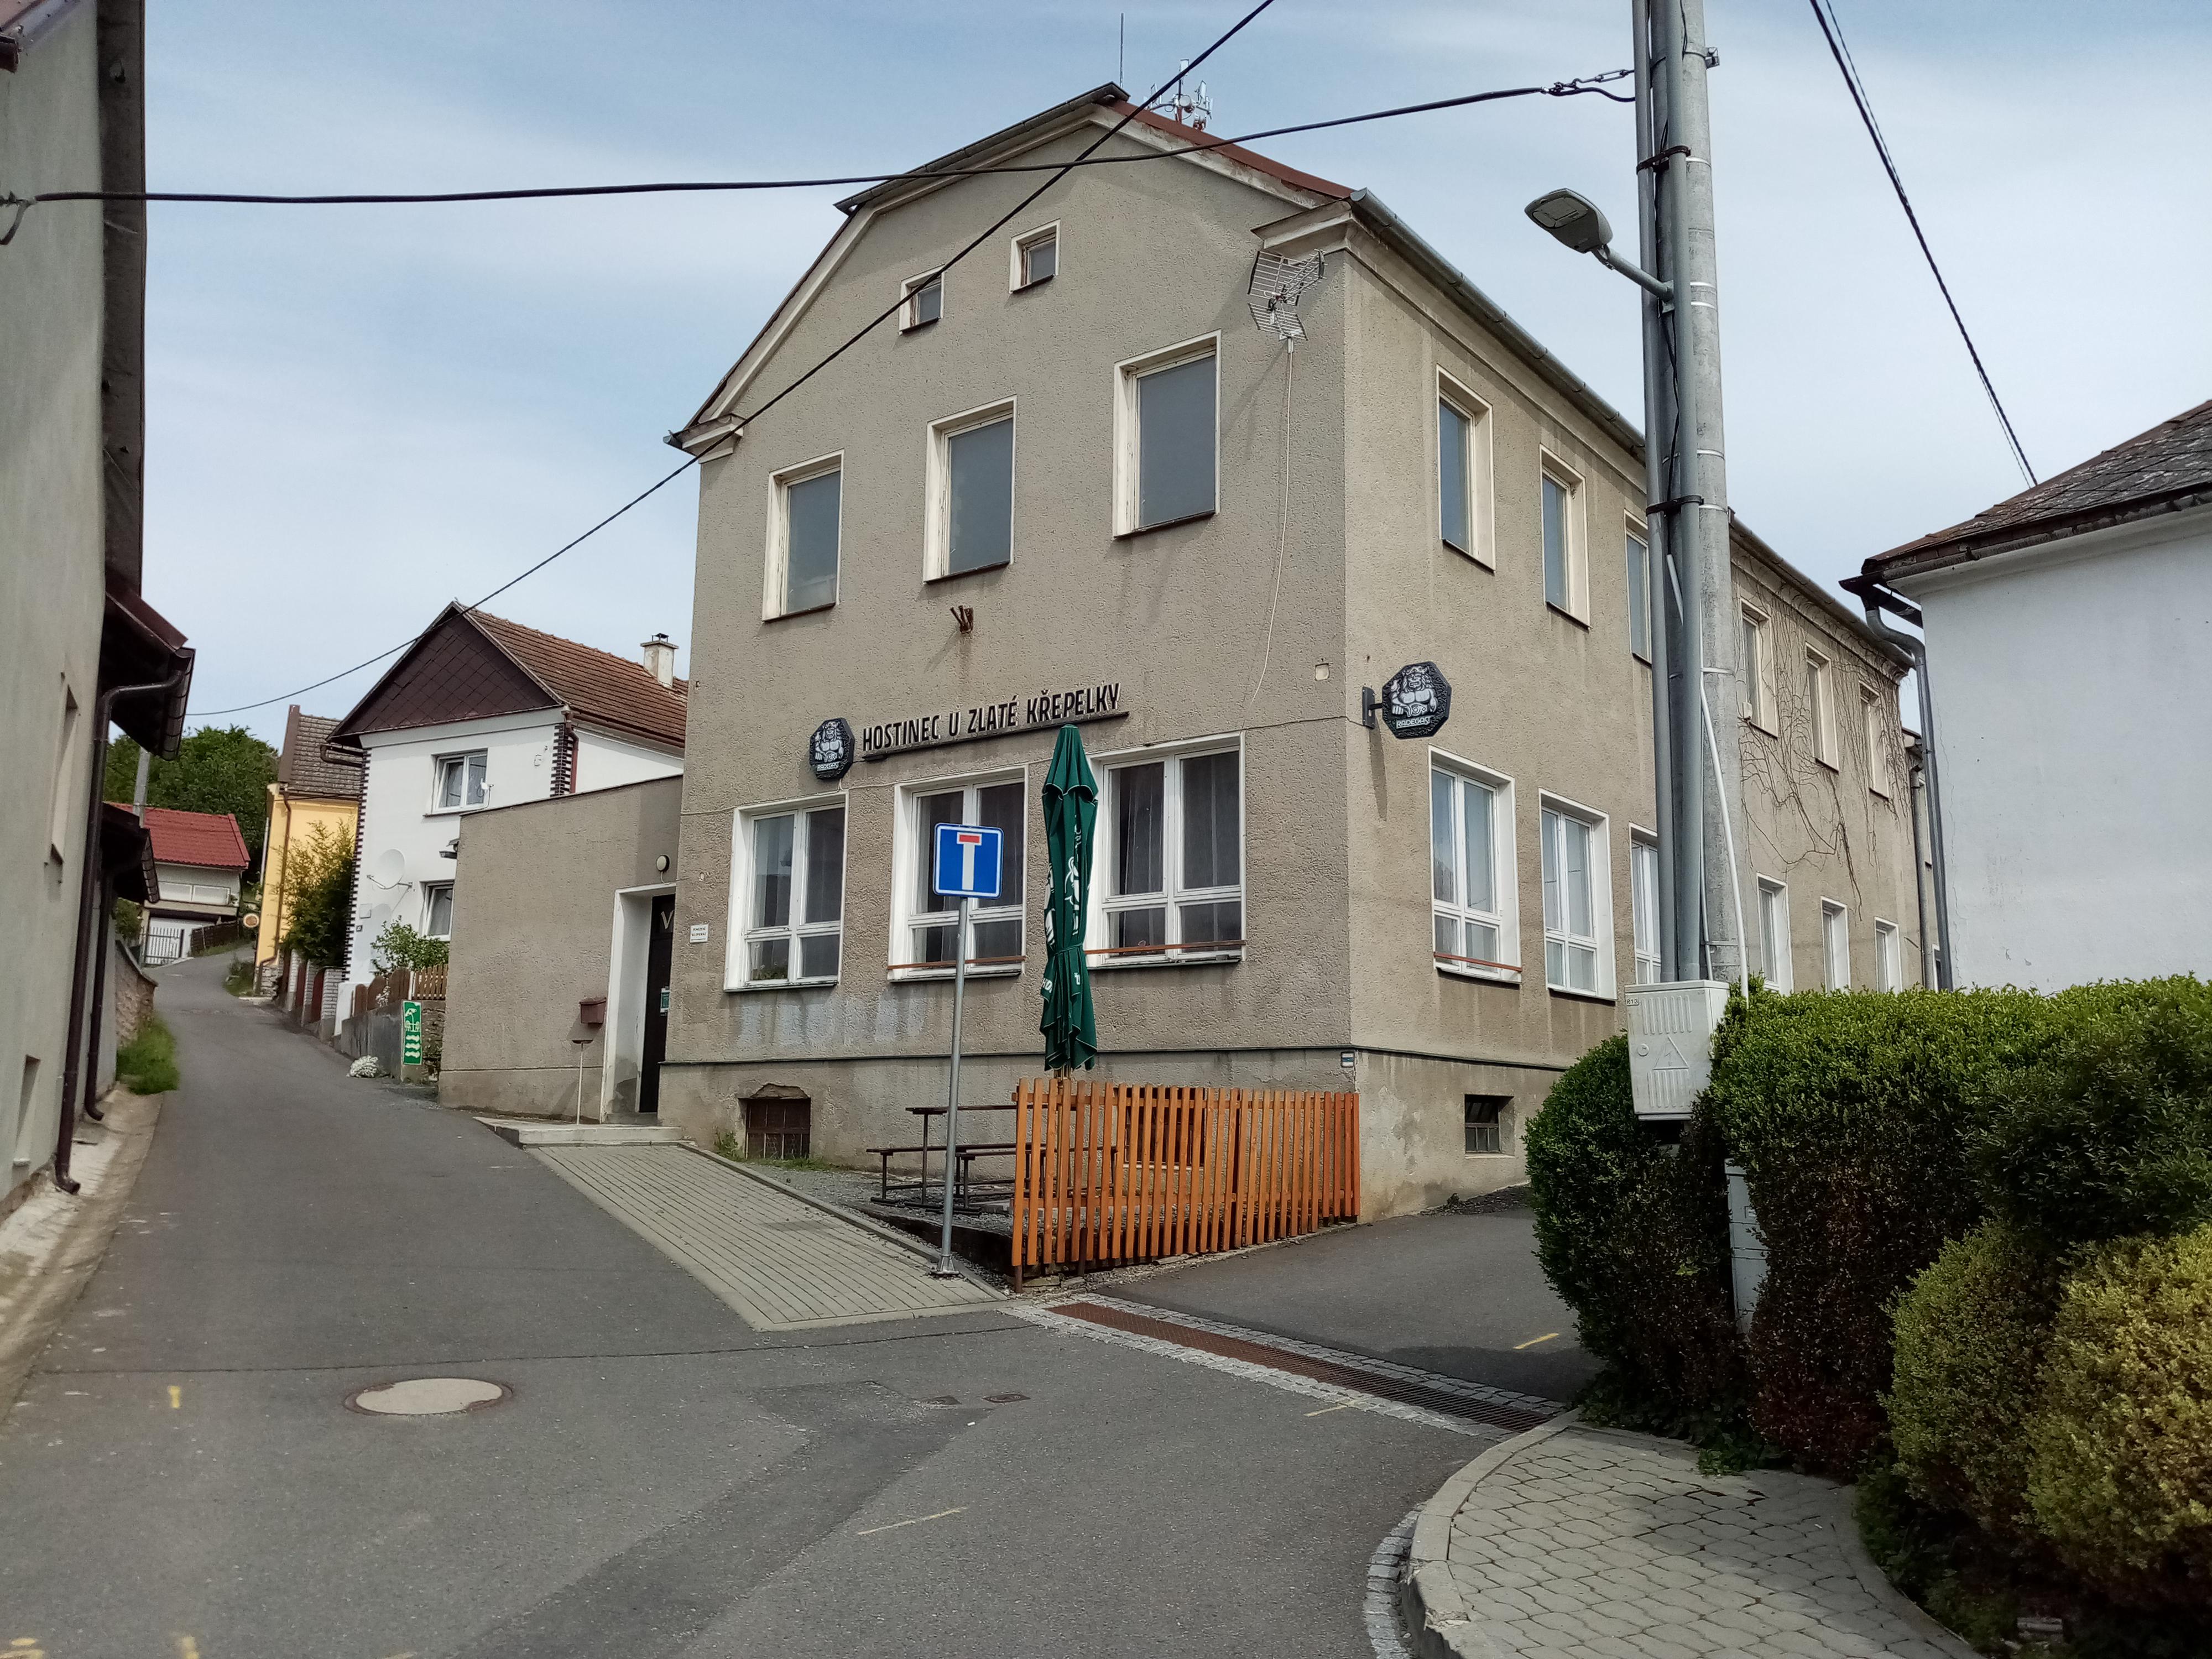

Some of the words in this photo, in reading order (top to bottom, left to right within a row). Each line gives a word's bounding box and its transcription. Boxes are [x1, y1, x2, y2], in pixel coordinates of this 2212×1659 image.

[863, 714, 941, 752] HOSTINEC
[949, 712, 961, 736] U
[968, 695, 1019, 733] ZLATÉ
[1027, 683, 1120, 723] KŘEPELKY
[1396, 716, 1431, 728] RADEGAST
